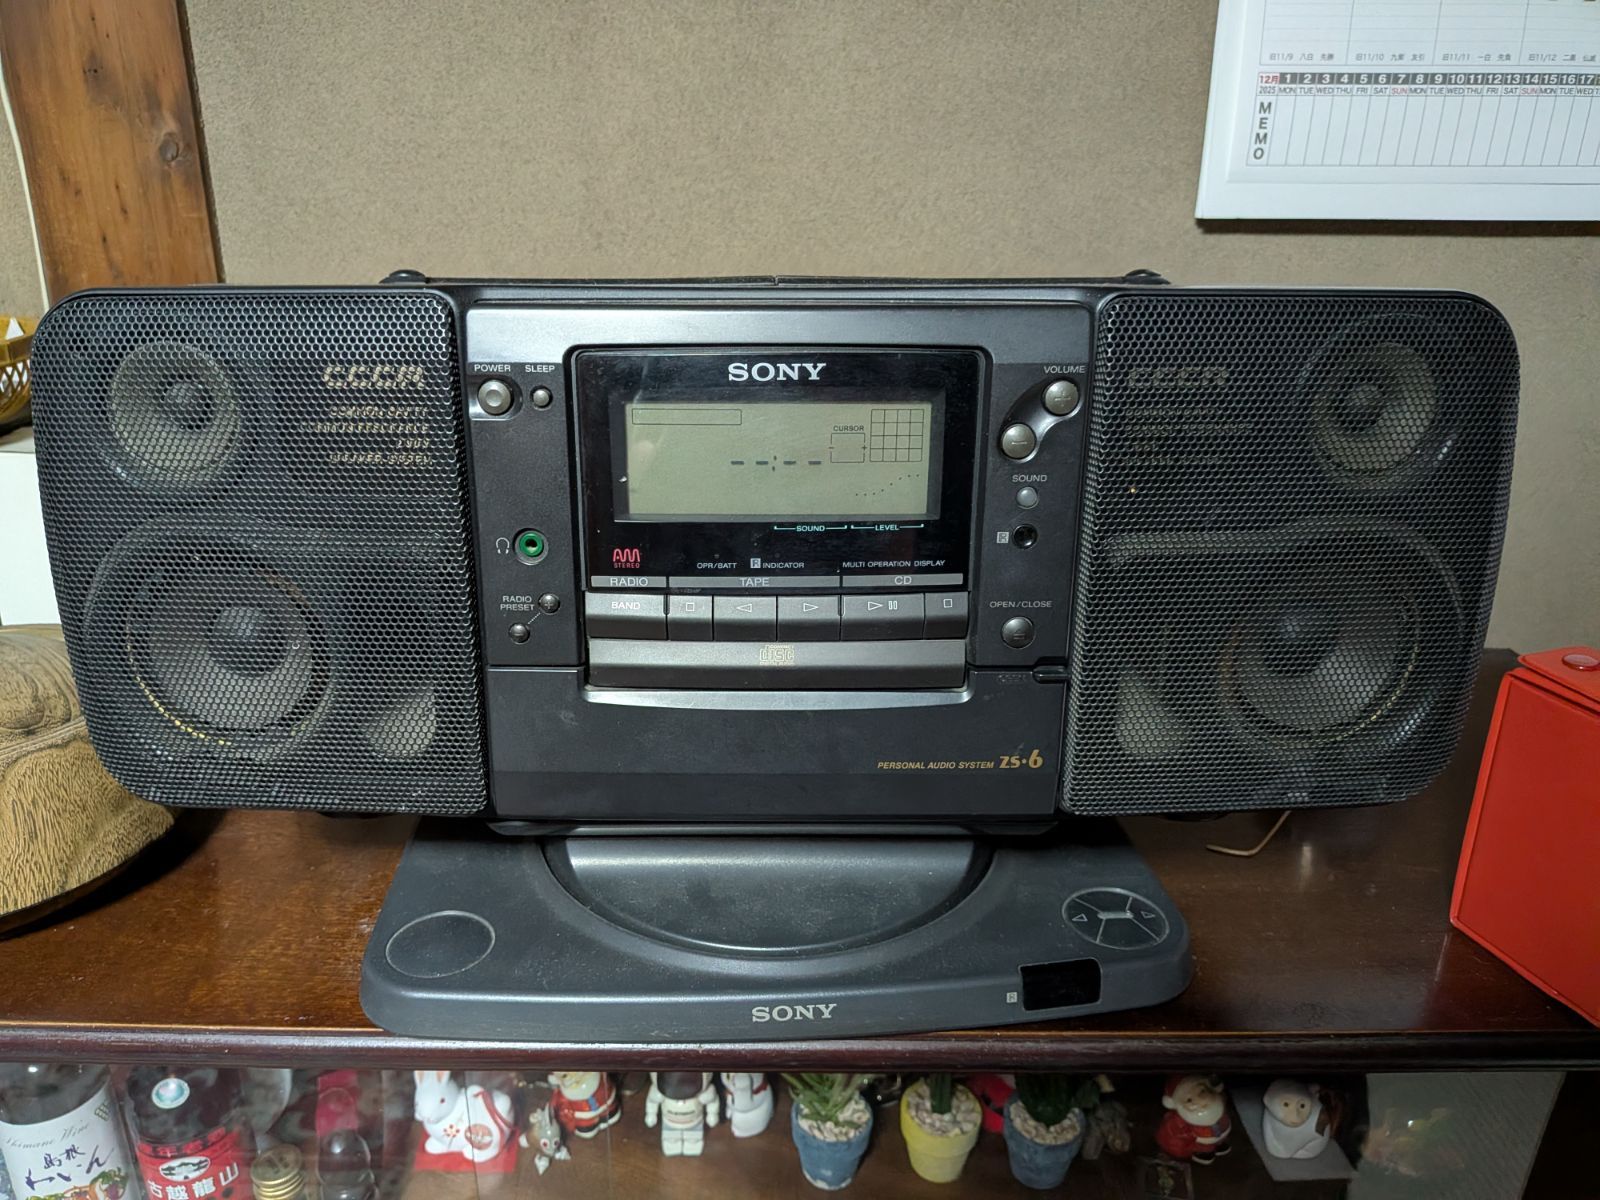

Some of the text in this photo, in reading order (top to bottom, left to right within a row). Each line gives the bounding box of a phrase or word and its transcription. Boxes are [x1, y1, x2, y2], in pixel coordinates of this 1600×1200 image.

[1259, 74, 1280, 84] 12月
[1285, 74, 1291, 84] 1
[1303, 74, 1311, 84] 2
[1322, 74, 1330, 84] 3
[1340, 74, 1349, 84] 4
[1360, 74, 1368, 84] 5
[1378, 74, 1387, 84] 6
[1397, 74, 1406, 84] 7
[1416, 74, 1424, 84] 8
[1434, 74, 1443, 84] 9
[1451, 74, 1465, 84] 10
[1469, 74, 1482, 84] 11
[1487, 74, 1502, 84] 12
[1506, 74, 1521, 84] 13
[1525, 74, 1539, 84] 14
[1543, 74, 1557, 84] 15
[1561, 74, 1576, 84] 16
[1580, 74, 1594, 84] 17
[1258, 87, 1276, 95] 2025
[1279, 87, 1296, 95] MON
[1299, 87, 1313, 95] TUE
[1316, 87, 1334, 95] WED
[1336, 87, 1351, 95] THU
[1356, 87, 1368, 95] FRI
[1373, 87, 1388, 95] SAT
[1391, 87, 1408, 95] SUN
[1409, 87, 1427, 95] MON
[1430, 87, 1444, 95] TUE
[1447, 87, 1464, 95] WED
[1467, 87, 1482, 95] THU
[1486, 87, 1499, 95] FRI
[1504, 87, 1518, 95] SAT
[1521, 87, 1537, 95] SUN
[1539, 87, 1556, 95] MON
[1559, 87, 1574, 95] TUE
[1576, 87, 1593, 95] WED
[1252, 101, 1272, 160] MEMO
[474, 364, 511, 373] POWER
[525, 364, 556, 373] SLEEP
[728, 362, 827, 382] SONY
[1044, 365, 1086, 374] VOLUME
[1012, 474, 1048, 483] SOUND
[796, 525, 826, 533] SOUND
[696, 562, 737, 570] OPR/BATT
[762, 562, 805, 570] INDICATOR
[842, 559, 946, 569] MULTI OPERATION DISPLAY
[610, 577, 649, 587] RADIO
[740, 577, 770, 587] TAPE
[894, 575, 912, 585] CD
[502, 595, 532, 604] RADIO
[500, 603, 535, 612] PRESET
[611, 601, 641, 610] BAND
[989, 600, 1053, 609] OPEN/CLOSE
[877, 761, 926, 770] PERSONAL
[927, 761, 956, 770] AUDIO
[958, 761, 994, 770] SYSTEM
[752, 1003, 837, 1022] SONY
